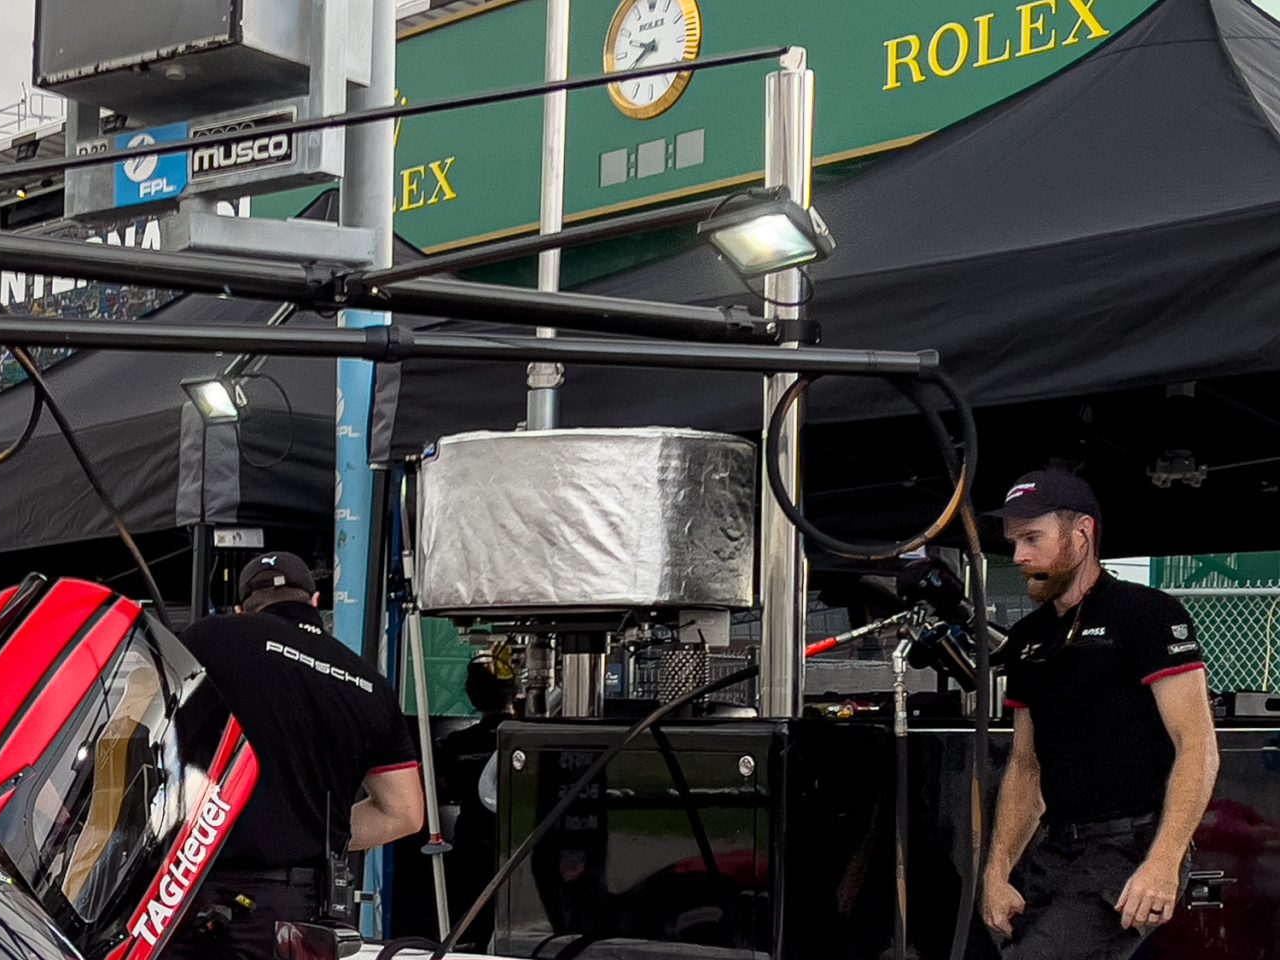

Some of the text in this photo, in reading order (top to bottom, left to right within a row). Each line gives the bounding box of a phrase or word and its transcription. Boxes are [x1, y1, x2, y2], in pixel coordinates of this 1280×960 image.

[882, 0, 1110, 90] ROLEX
[139, 178, 174, 199] FPL
[265, 640, 373, 693] PORSCHE
